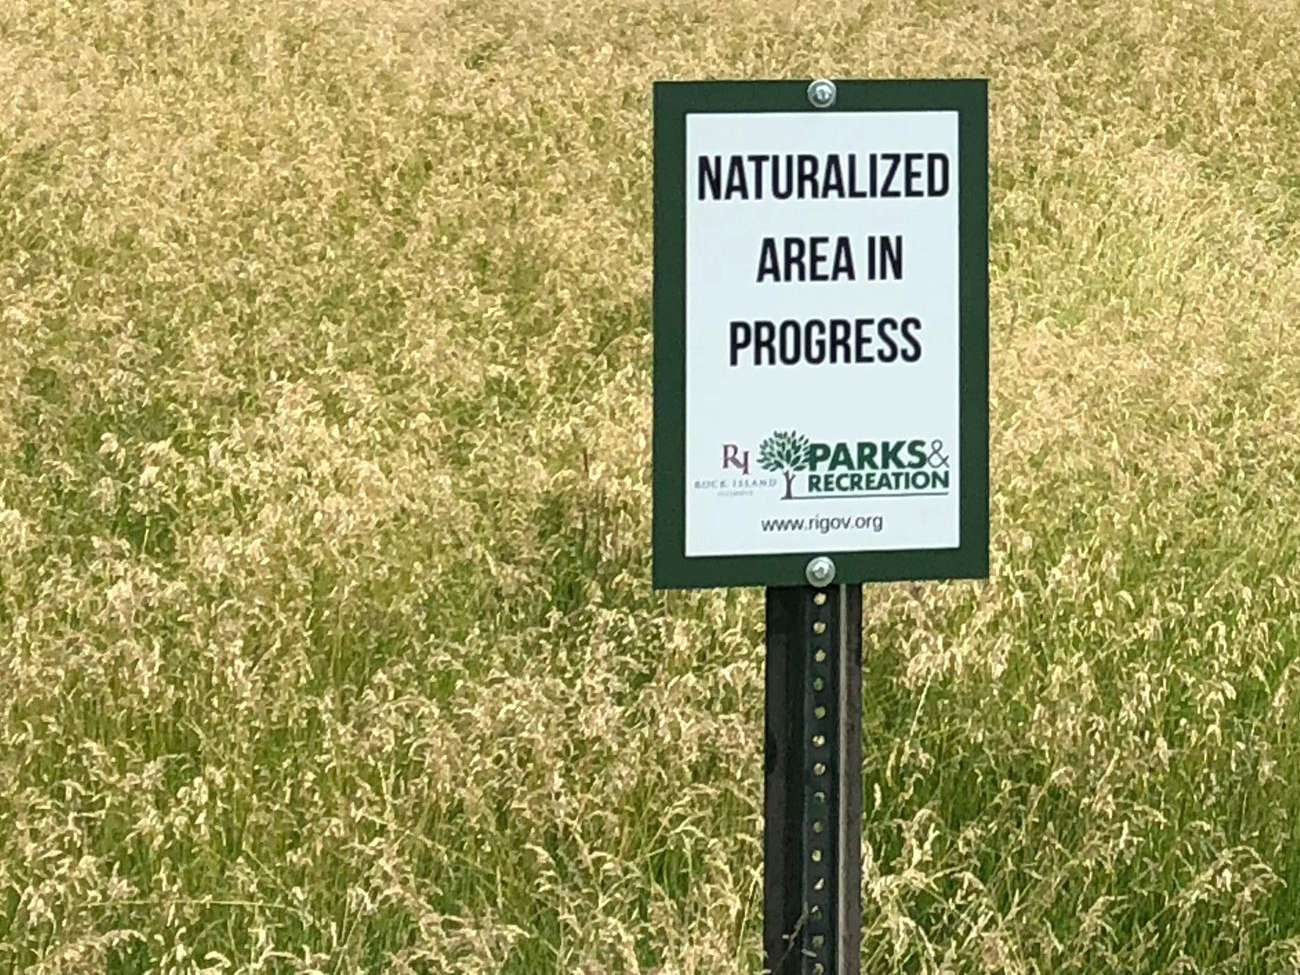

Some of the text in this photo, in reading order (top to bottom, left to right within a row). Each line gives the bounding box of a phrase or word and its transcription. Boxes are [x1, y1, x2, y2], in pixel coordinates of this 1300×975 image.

[697, 153, 950, 201] NATURALIZED
[756, 235, 903, 282] AREA IN
[729, 317, 922, 366] PROGRESS
[808, 471, 950, 492] RECREATION
[761, 513, 884, 534] www.rigov.org
